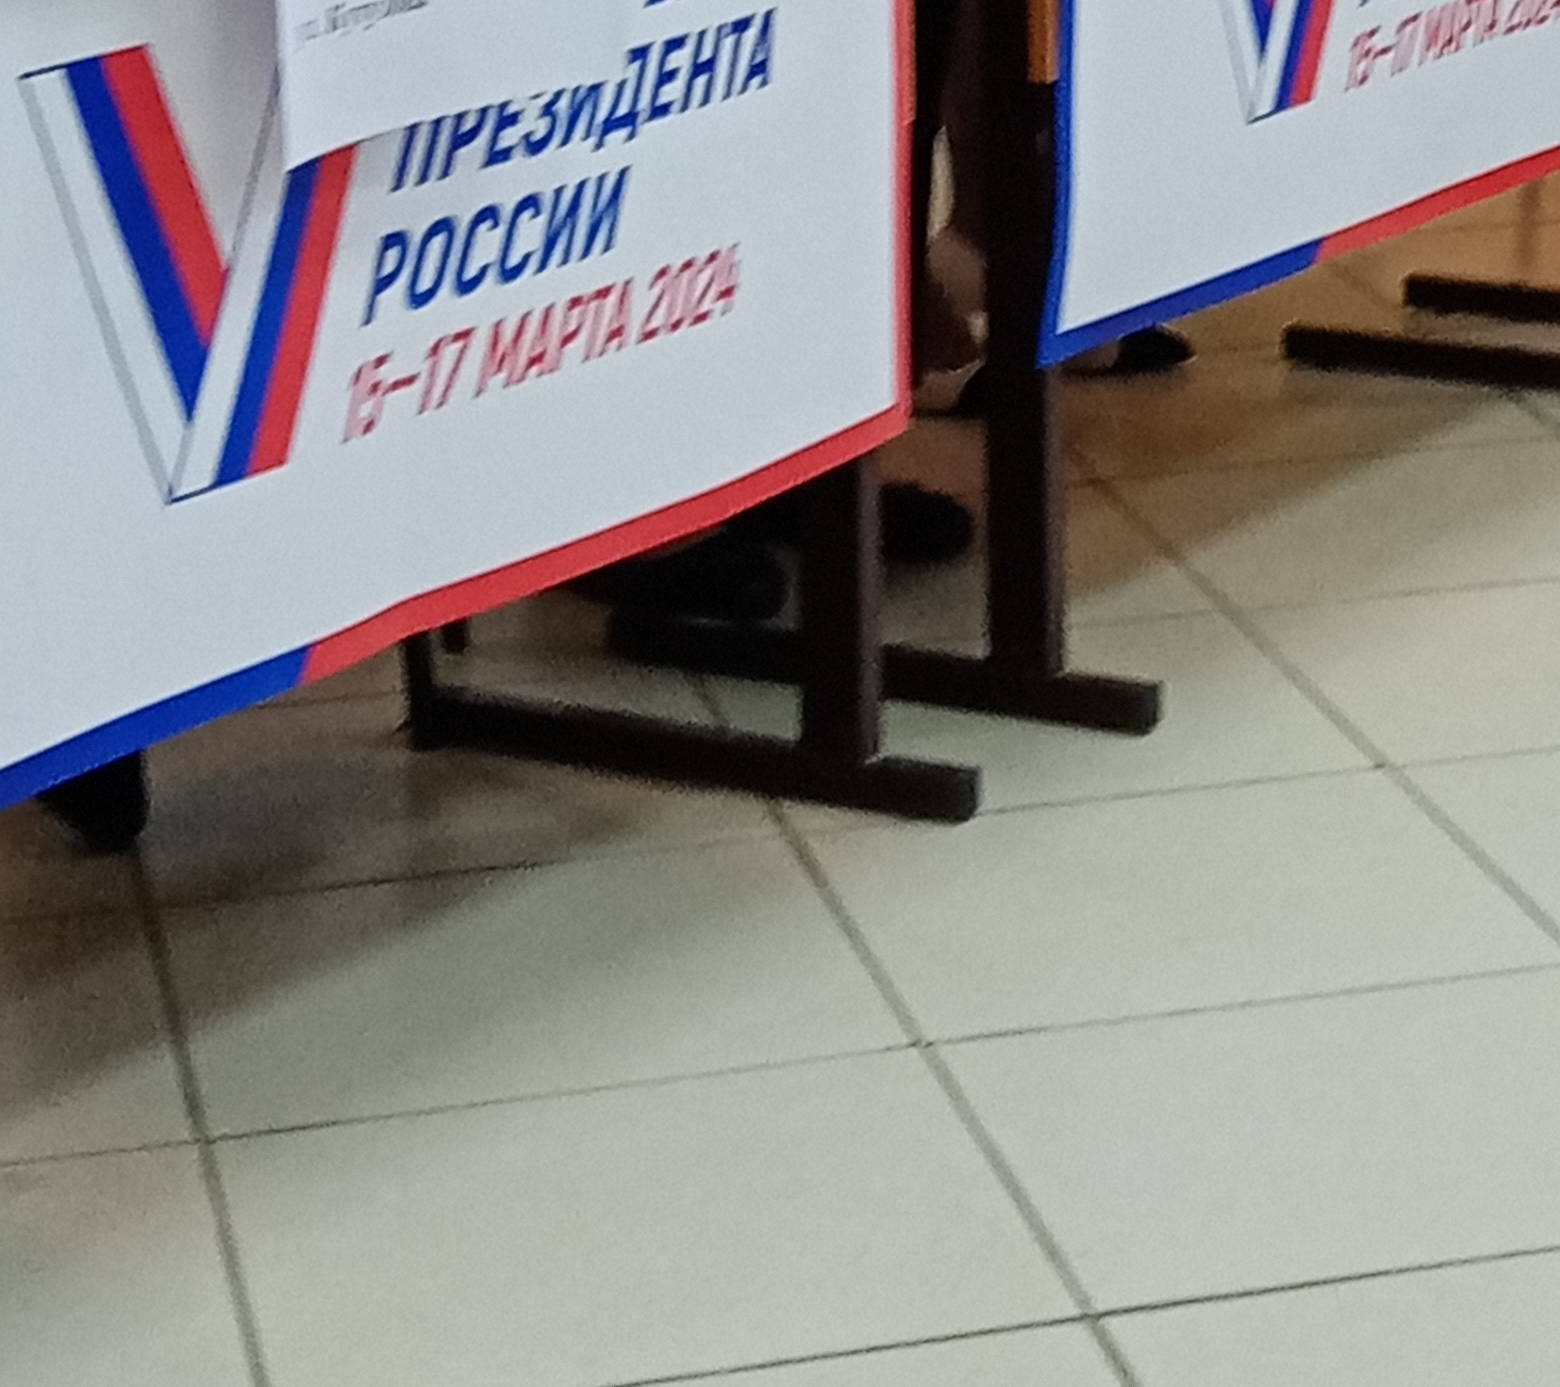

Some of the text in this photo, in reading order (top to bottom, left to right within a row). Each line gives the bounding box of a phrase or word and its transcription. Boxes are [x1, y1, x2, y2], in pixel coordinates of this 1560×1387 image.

[359, 164, 633, 329] РОССИИ
[471, 275, 636, 399] МАРТА
[635, 240, 742, 347] 2024
